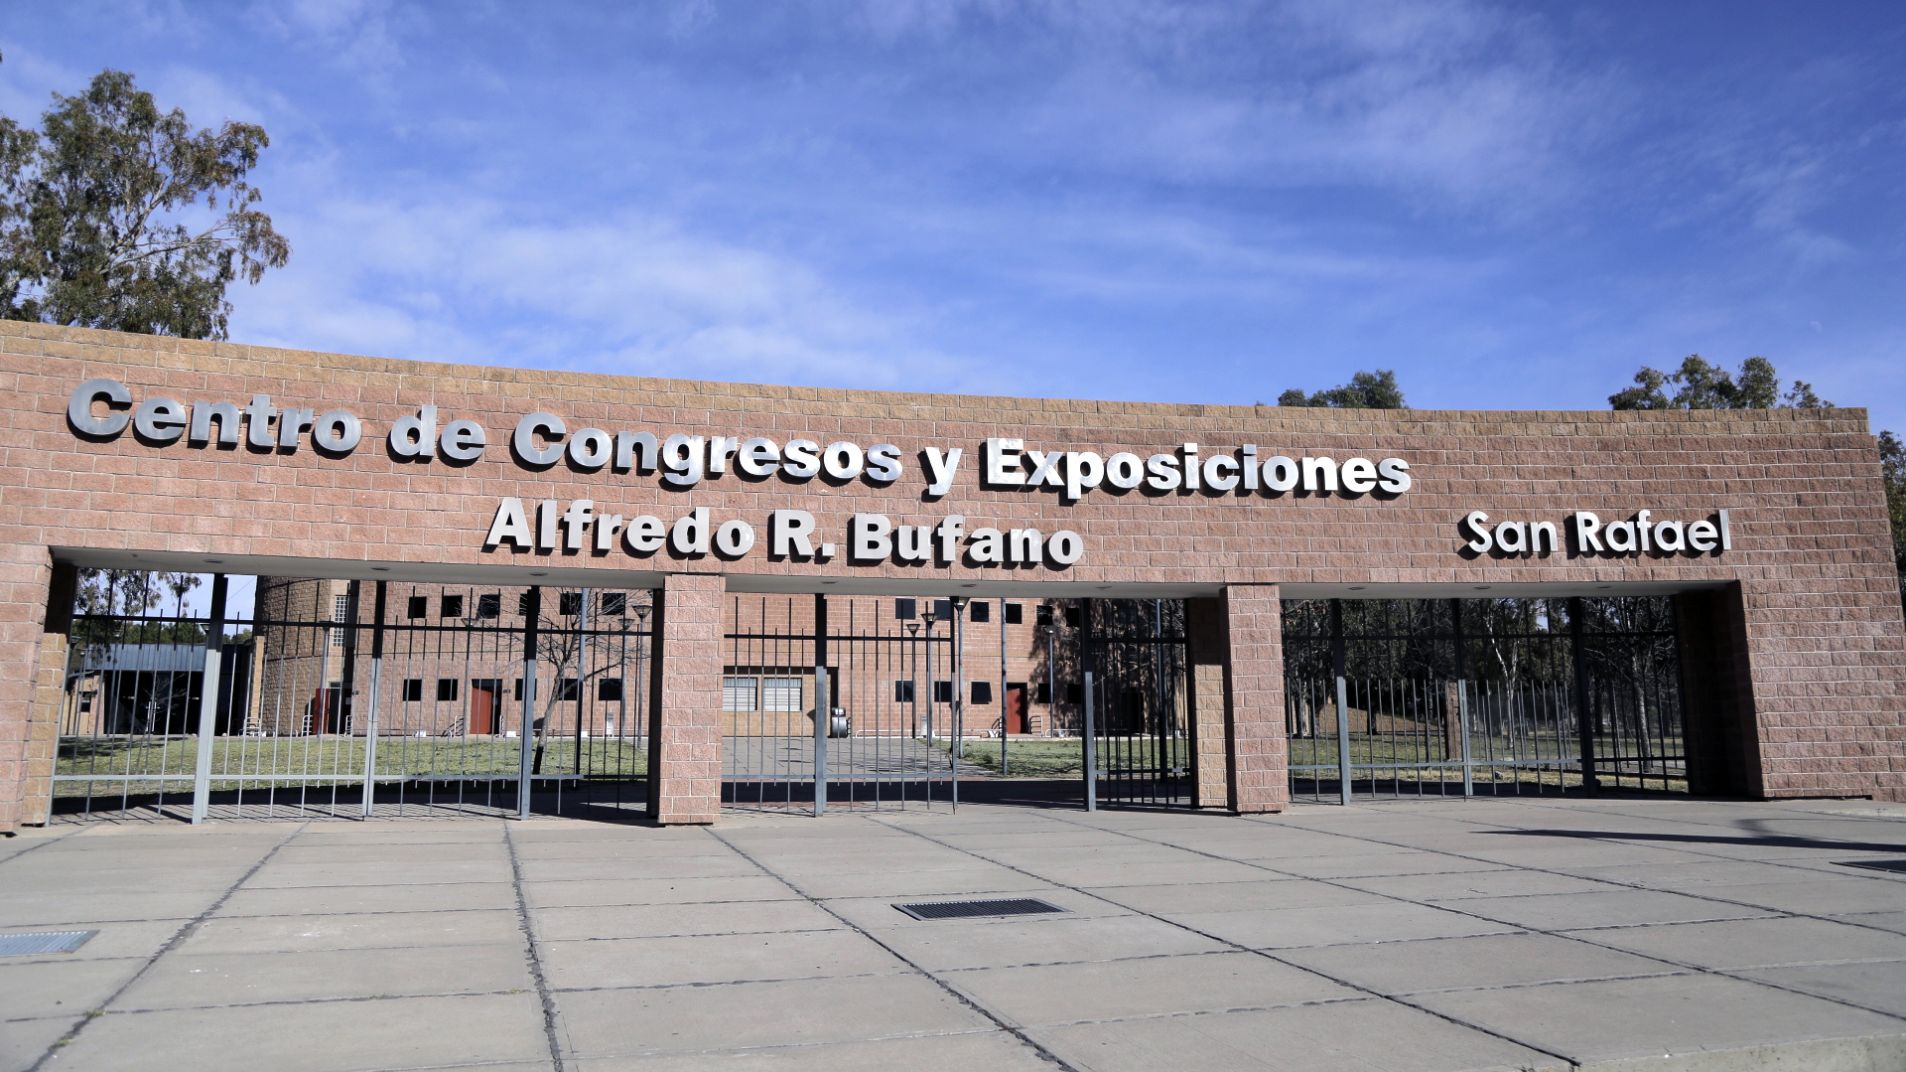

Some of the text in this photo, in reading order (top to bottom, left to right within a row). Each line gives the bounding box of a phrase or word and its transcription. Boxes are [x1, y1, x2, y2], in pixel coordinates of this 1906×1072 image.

[68, 378, 1412, 499] Centro de Congresos y Exposiciones
[486, 497, 1084, 565] Alfredo R. Bufano
[1465, 509, 1731, 553] San Rafael
